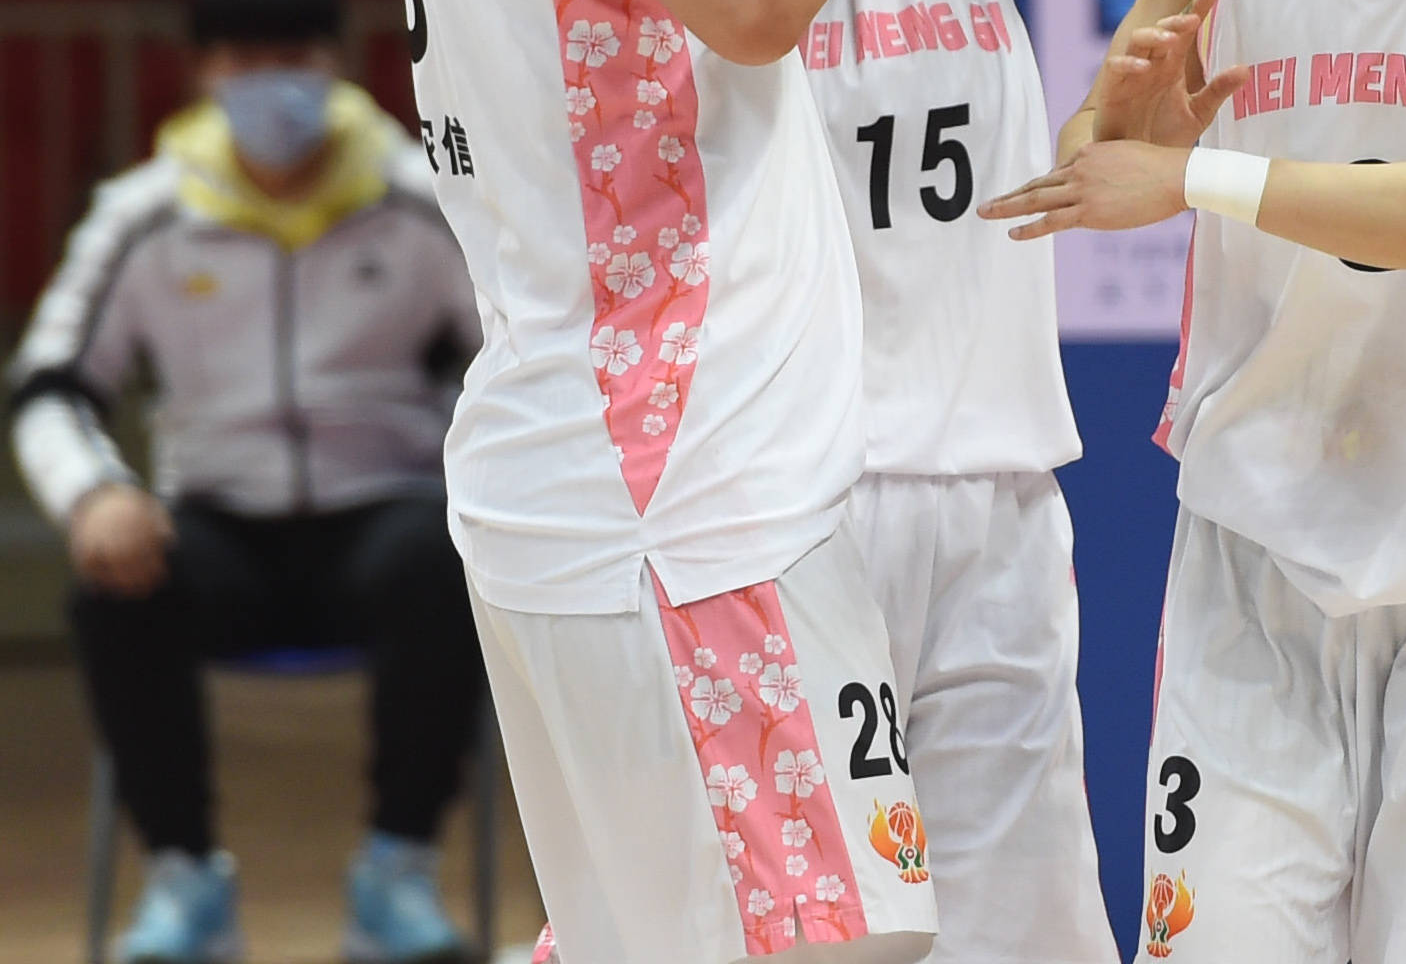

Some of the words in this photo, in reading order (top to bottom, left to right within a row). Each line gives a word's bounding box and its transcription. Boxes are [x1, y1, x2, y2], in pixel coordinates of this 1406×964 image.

[797, 21, 844, 70] EI
[856, 102, 973, 229] 15
[1154, 755, 1201, 854] 3
